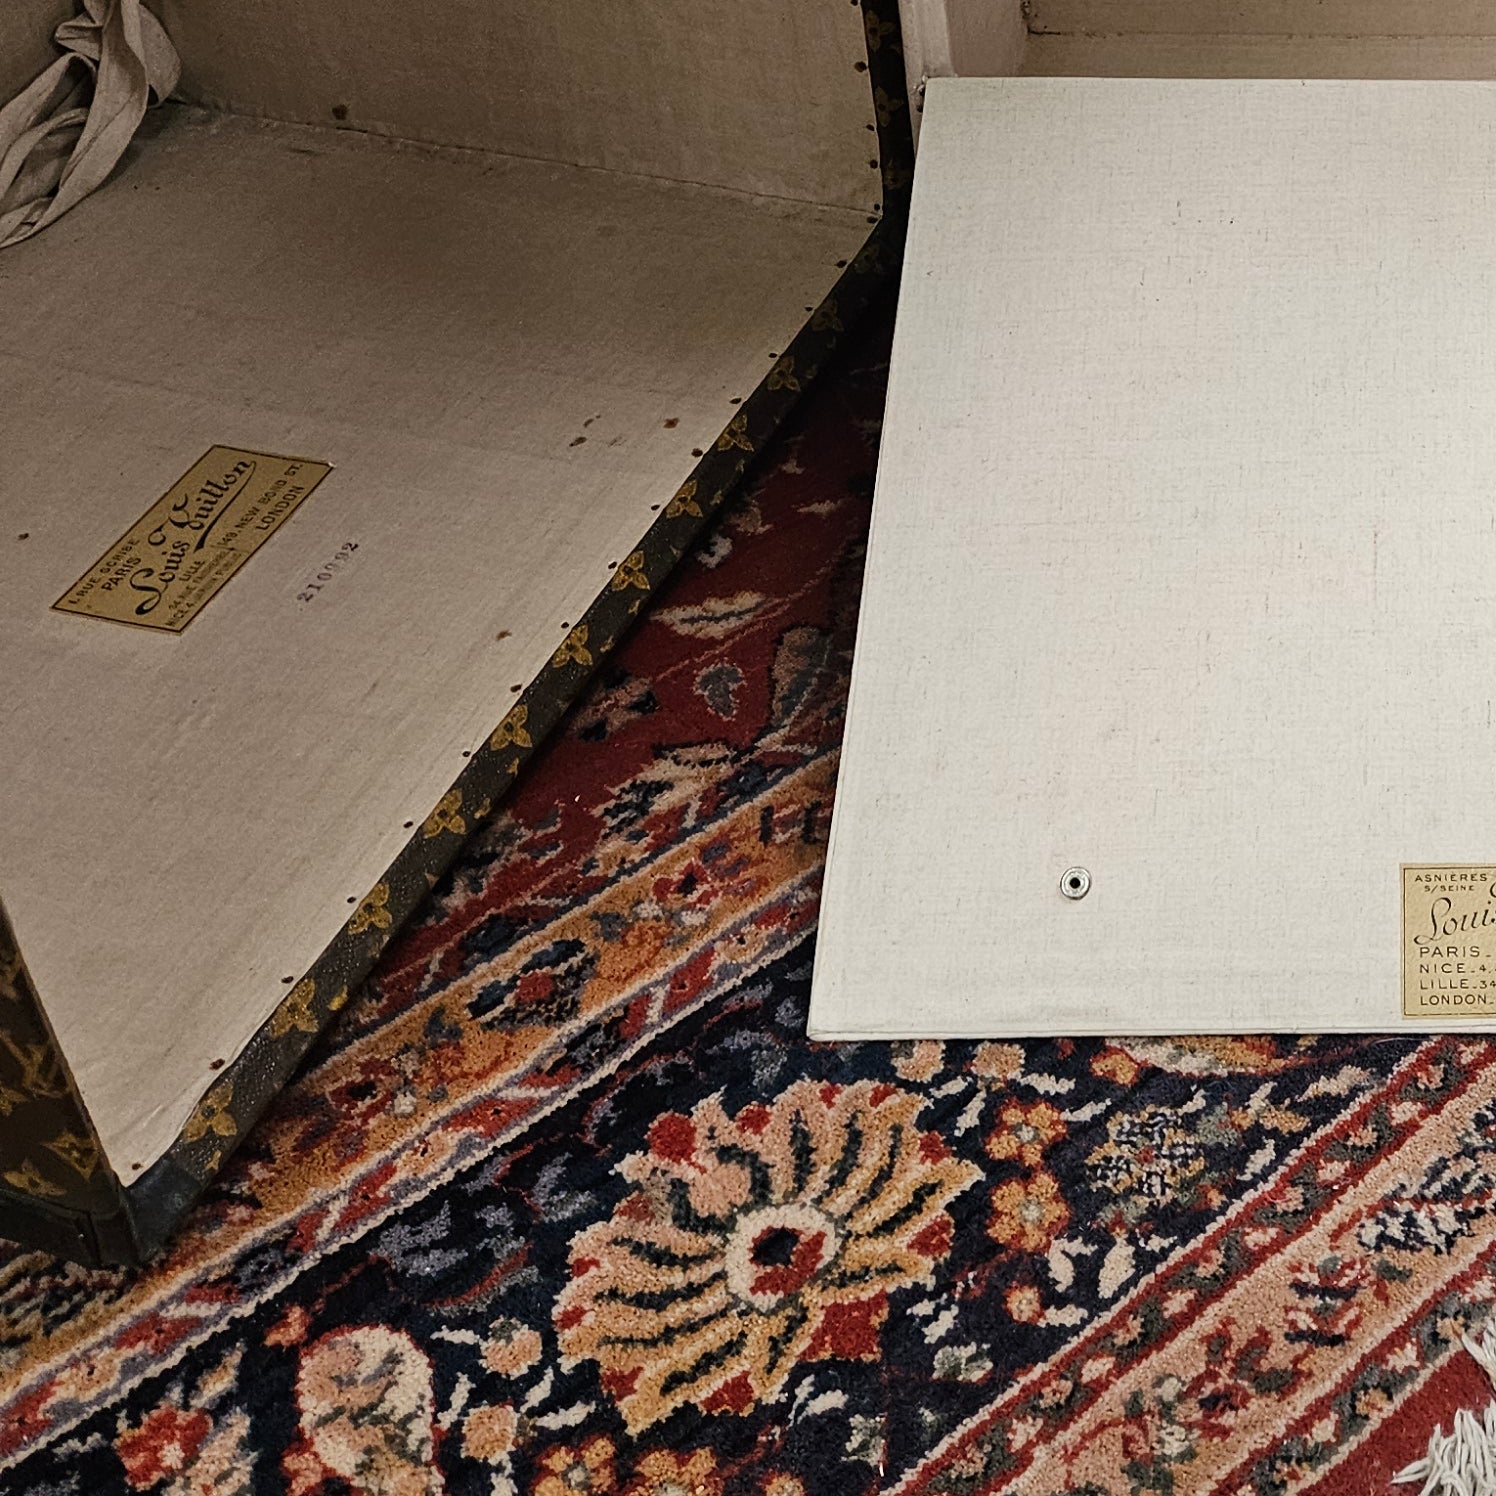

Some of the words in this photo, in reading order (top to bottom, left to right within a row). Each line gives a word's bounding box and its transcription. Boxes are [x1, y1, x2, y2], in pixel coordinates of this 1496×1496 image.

[148, 461, 257, 546] Vuitton
[234, 506, 260, 528] NEW
[258, 480, 287, 504] BOND
[255, 486, 305, 530] LONDON
[101, 557, 141, 591] PARIS
[129, 540, 190, 615] Louis
[76, 577, 101, 597] RUE
[1425, 885, 1475, 893] S/SEINE
[1420, 946, 1480, 958] PARIS
[1420, 963, 1466, 973] NICE
[1420, 979, 1469, 990] LILLE
[1420, 994, 1487, 1005] LONDON
